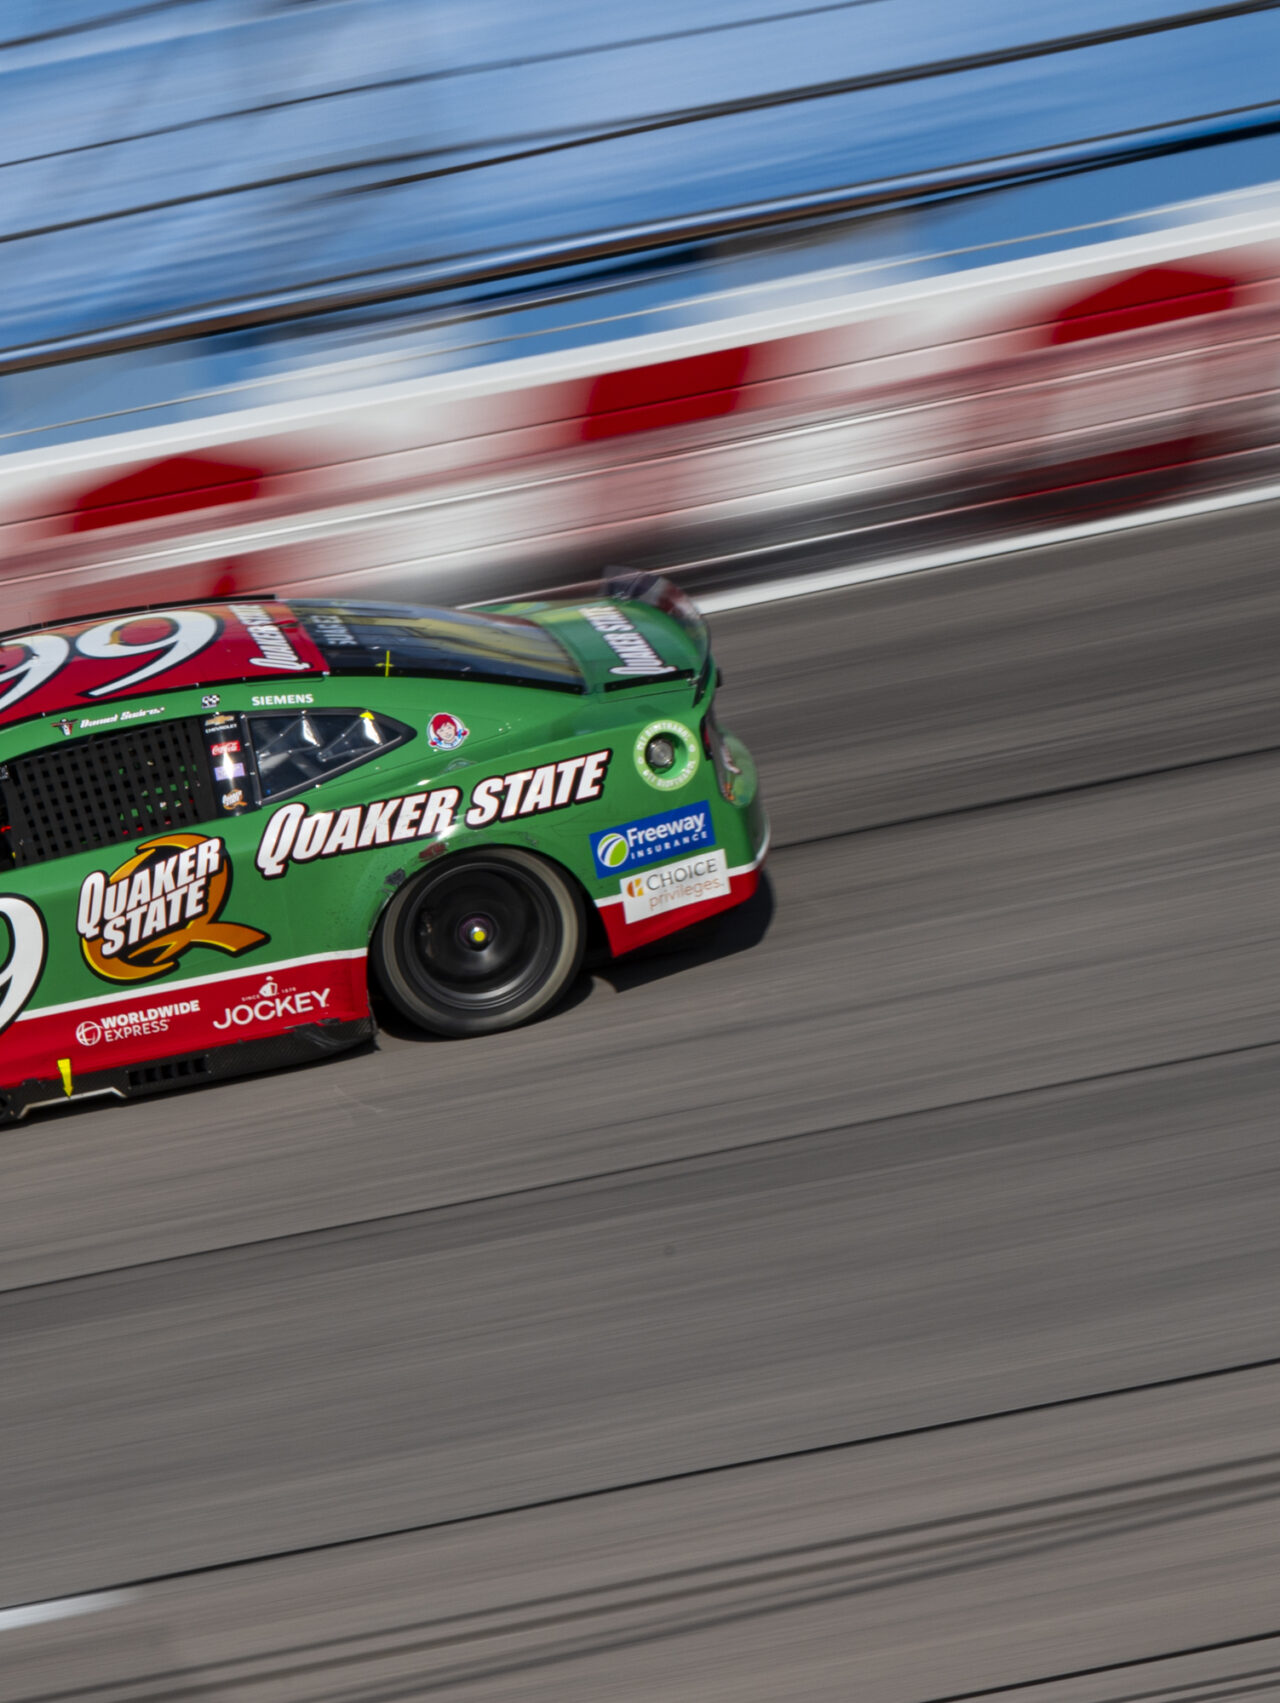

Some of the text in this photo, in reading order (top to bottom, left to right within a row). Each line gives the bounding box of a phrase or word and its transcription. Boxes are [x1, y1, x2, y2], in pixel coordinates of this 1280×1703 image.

[249, 625, 311, 670] QUAKER
[603, 632, 678, 675] QUAKER
[251, 693, 314, 706] SIEMENS
[256, 750, 610, 876] QUAKER STATE
[626, 812, 705, 848] Freeway
[631, 831, 708, 860] INSURANCE
[77, 837, 222, 940] QUAKER
[646, 858, 718, 891] CHOICE
[649, 877, 721, 911] privileges
[102, 876, 207, 956] STATE
[101, 999, 201, 1030] WORLDWIDE
[212, 988, 331, 1030] JOCKEY
[104, 1020, 169, 1043] EXPRESS
